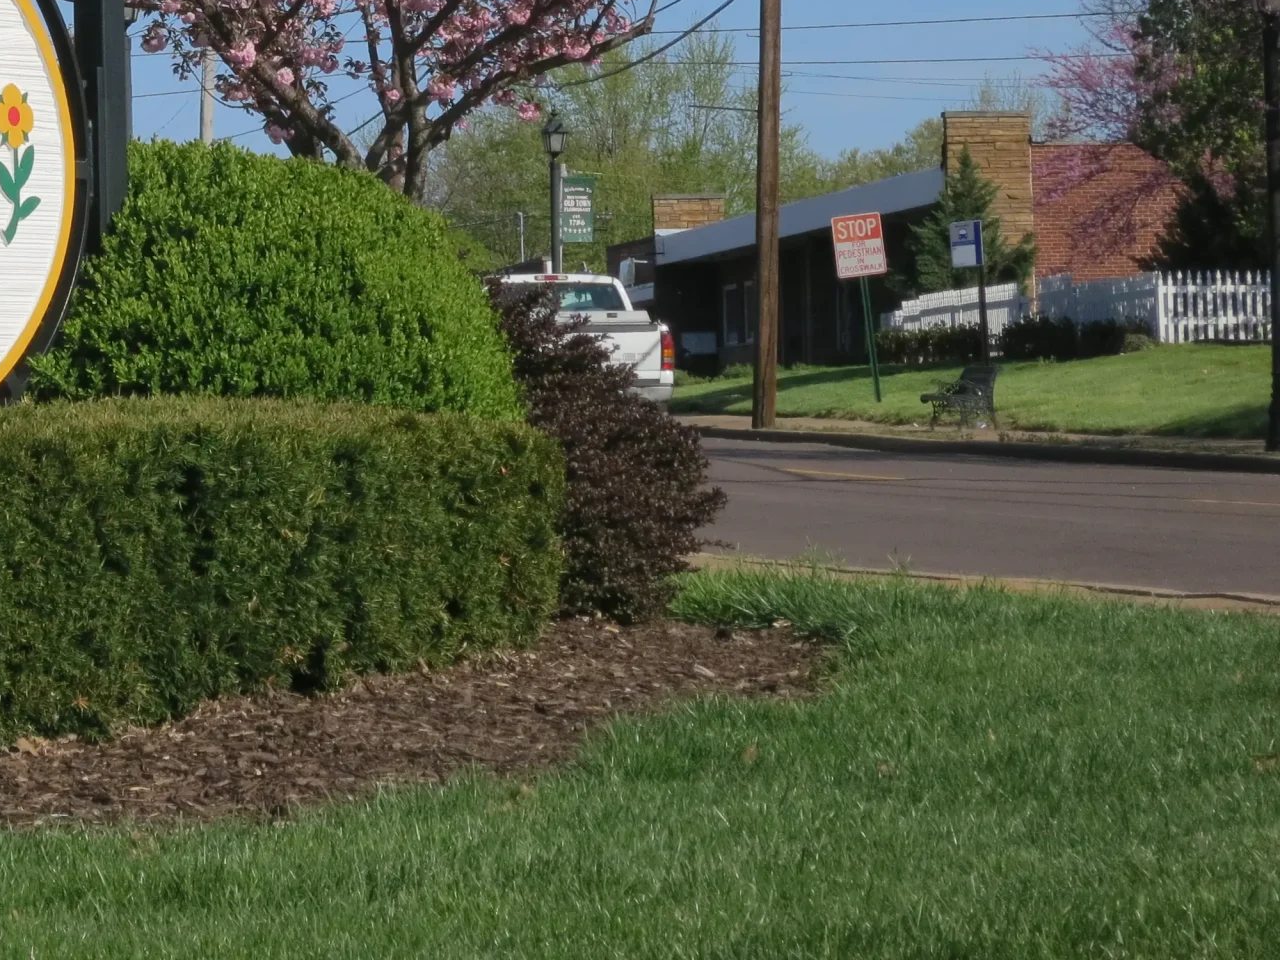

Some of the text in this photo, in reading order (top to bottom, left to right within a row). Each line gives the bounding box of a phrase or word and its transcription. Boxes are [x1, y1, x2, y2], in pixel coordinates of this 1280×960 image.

[836, 218, 877, 240] STOP
[838, 246, 883, 259] PEDESTRIAN
[840, 263, 884, 275] CROSSWALK
